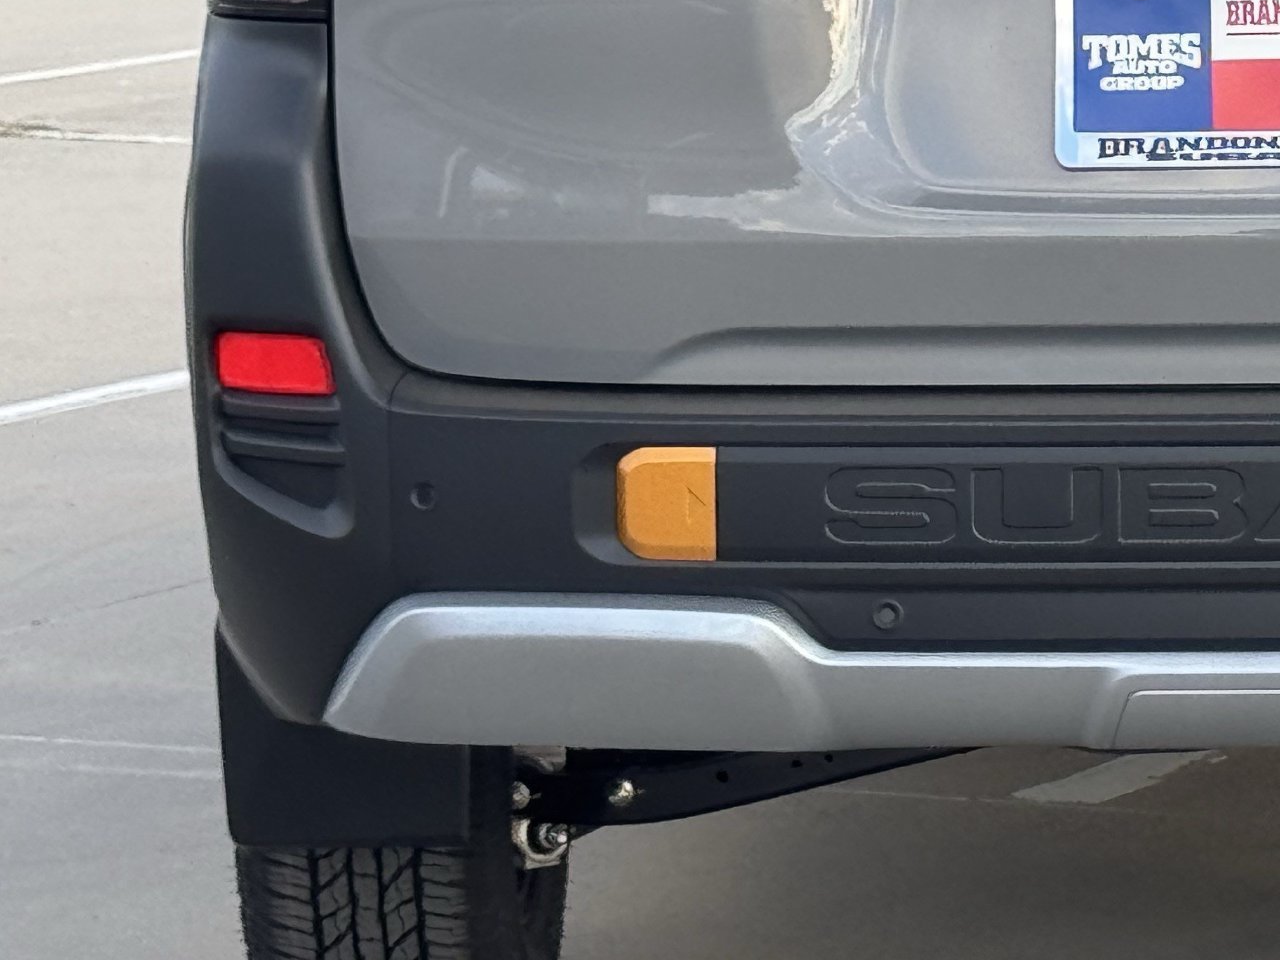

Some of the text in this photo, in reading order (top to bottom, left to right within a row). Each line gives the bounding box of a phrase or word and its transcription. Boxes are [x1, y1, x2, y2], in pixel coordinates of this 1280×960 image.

[1082, 32, 1202, 70] TOMES
[1112, 59, 1178, 74] AUTO
[1099, 75, 1185, 91] GROUP
[1097, 135, 1280, 159] BRANDON
